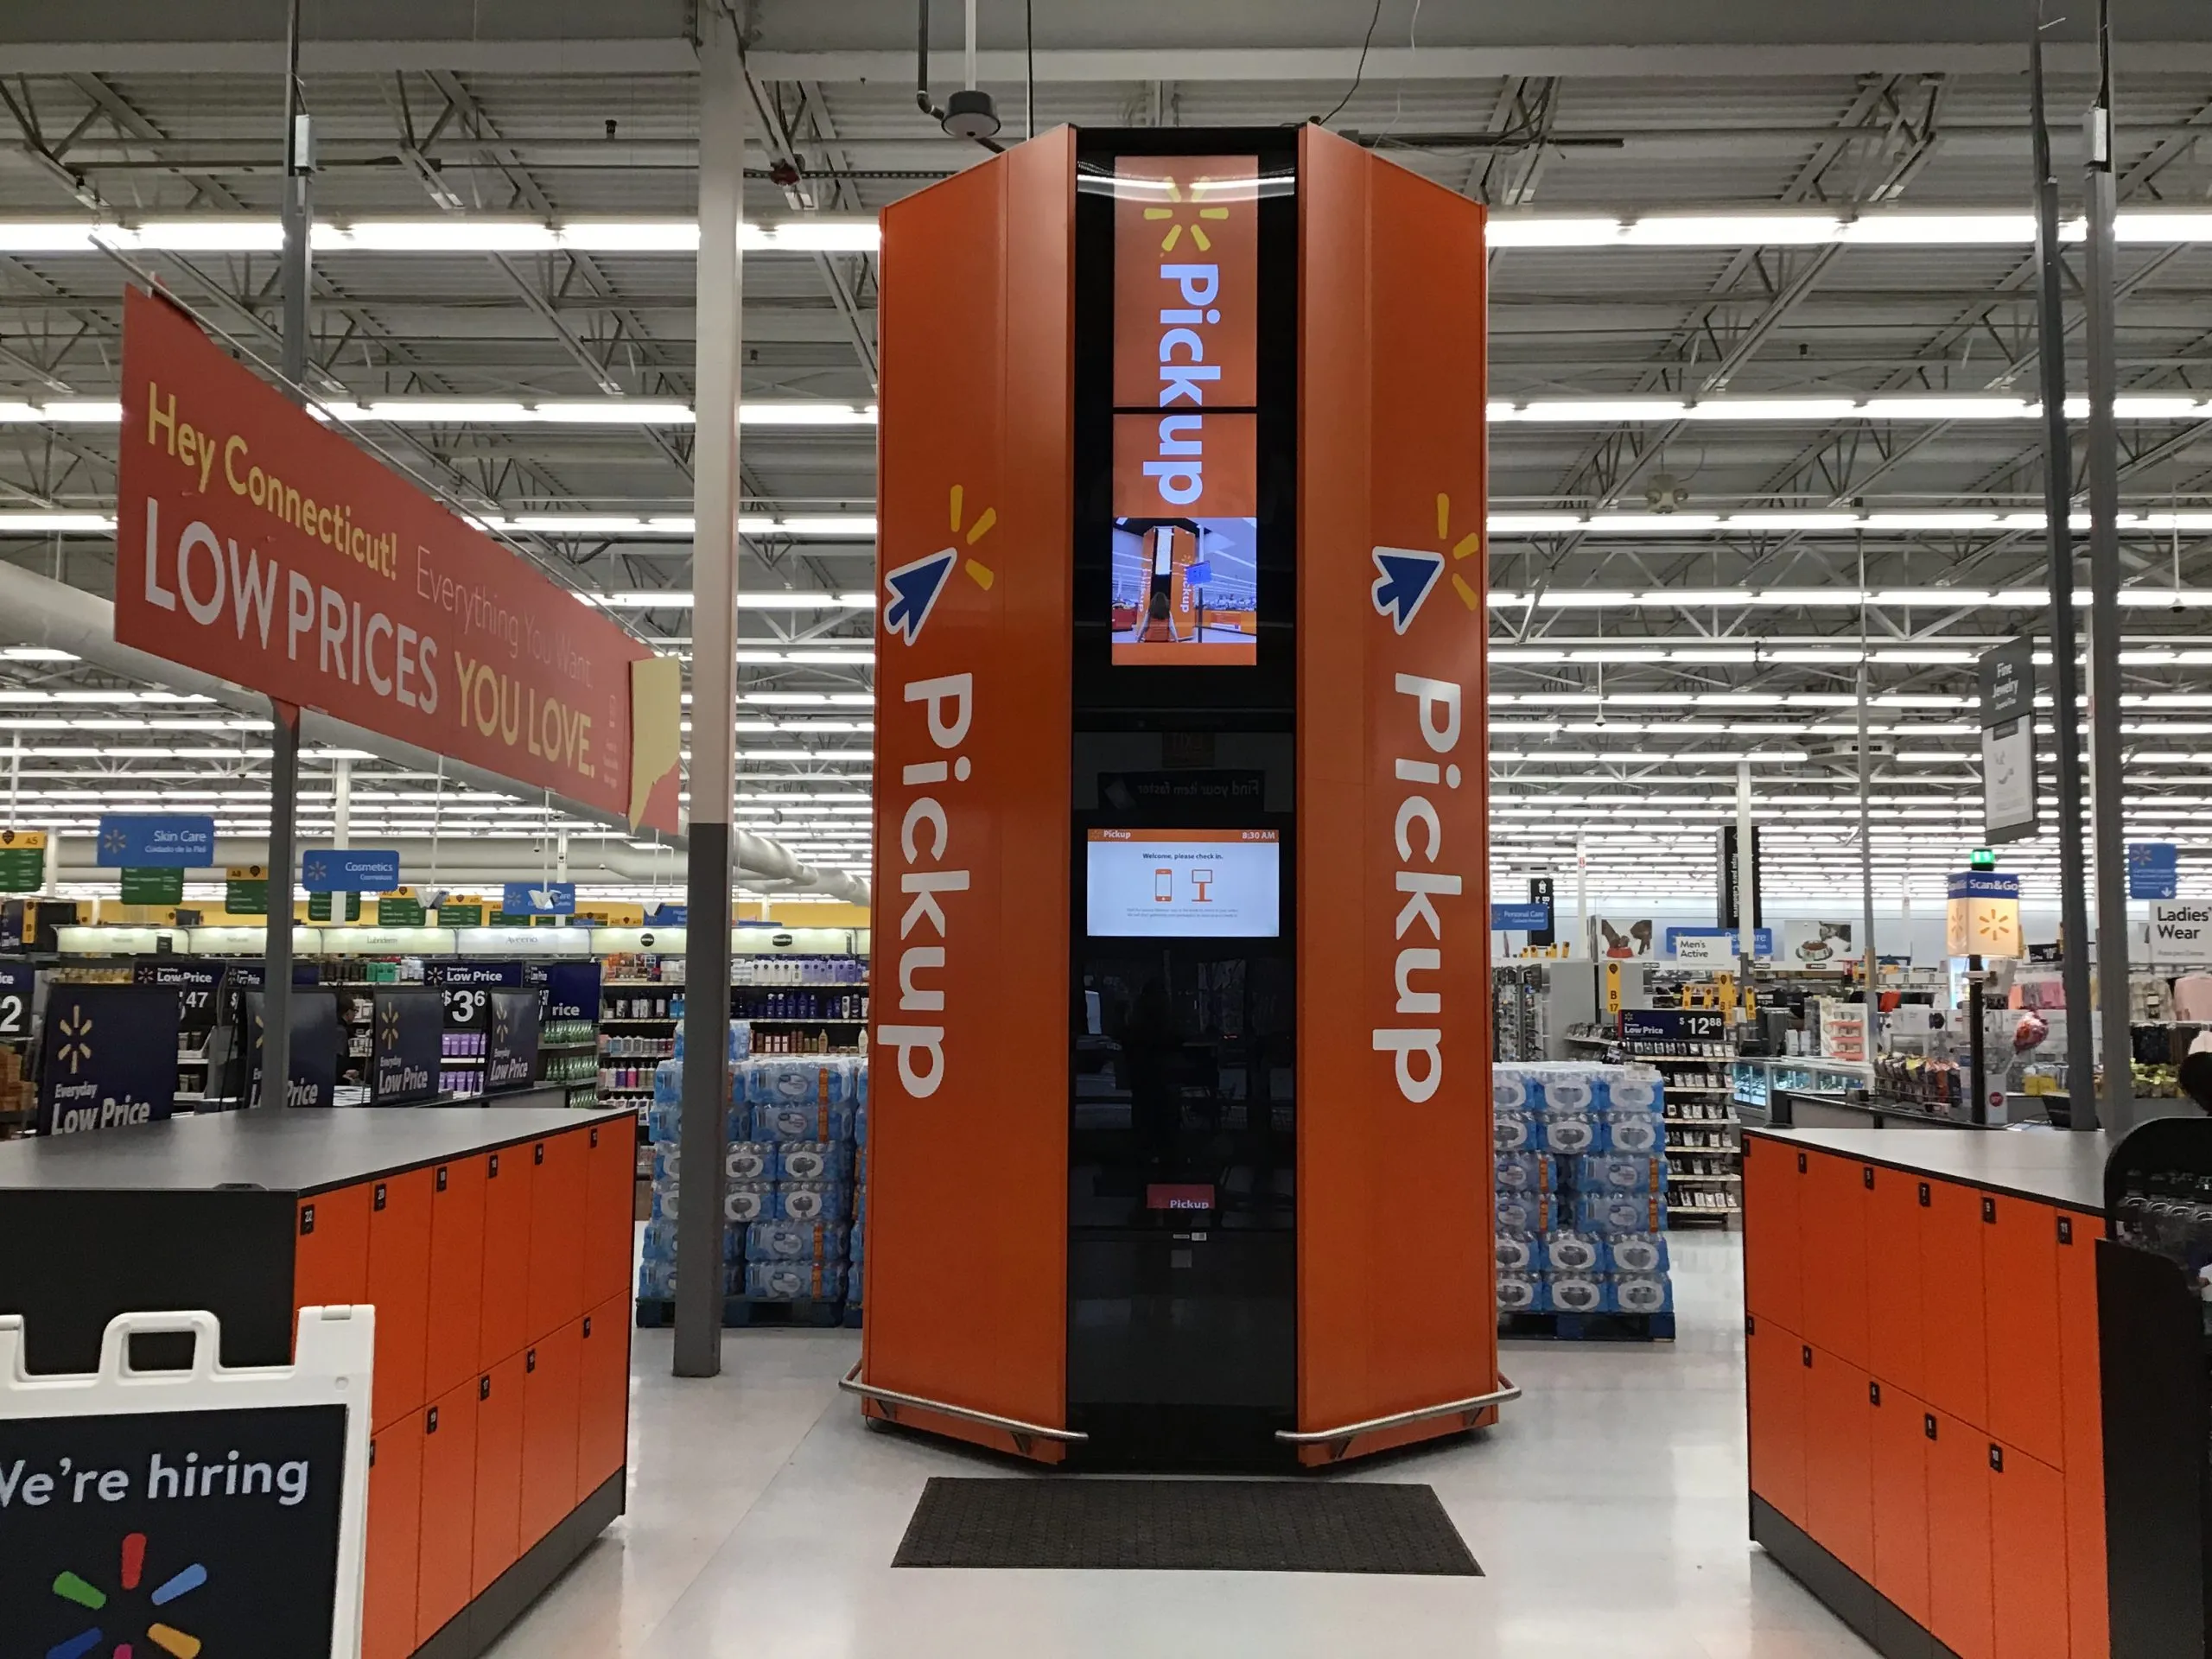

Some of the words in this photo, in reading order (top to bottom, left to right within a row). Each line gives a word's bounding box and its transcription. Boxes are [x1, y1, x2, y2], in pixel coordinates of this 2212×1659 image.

[1142, 264, 1221, 505] Pickup
[148, 382, 215, 493] Hey
[225, 435, 397, 580] Connecticut!
[417, 546, 518, 658] Everything
[524, 608, 551, 664] You
[145, 497, 279, 650] LOW
[289, 572, 439, 715] PRICES
[454, 651, 520, 746] YOU
[528, 688, 595, 778] LOVE.
[1997, 662, 2012, 678] Fine
[154, 830, 178, 842] Skin
[180, 830, 207, 842] Care
[1103, 830, 1131, 840] Pickup
[1242, 831, 1260, 840] 8:30
[1262, 831, 1275, 840] AM
[345, 861, 393, 872] Cosmetics
[877, 673, 972, 1098] Pickup
[1372, 672, 1462, 1103] Pickup
[1970, 880, 2018, 891] Scan&Go
[2158, 906, 2212, 921] Ladies'
[2158, 924, 2201, 939] Wear
[505, 936, 538, 944] Aveeno
[1680, 939, 1706, 948] Men's
[157, 972, 181, 982] Low
[183, 972, 213, 982] Price
[447, 971, 470, 982] Low
[474, 970, 503, 982] Price
[1624, 1026, 1642, 1034] Low
[490, 1060, 509, 1082] Low
[509, 1057, 528, 1078] Price
[378, 1068, 402, 1095] Low
[403, 1065, 428, 1091] Price
[55, 1081, 99, 1100] Everyday
[51, 1103, 99, 1135] Low
[100, 1095, 150, 1129] Price
[1170, 1199, 1209, 1209] Pickup
[148, 1450, 309, 1506] hiring
